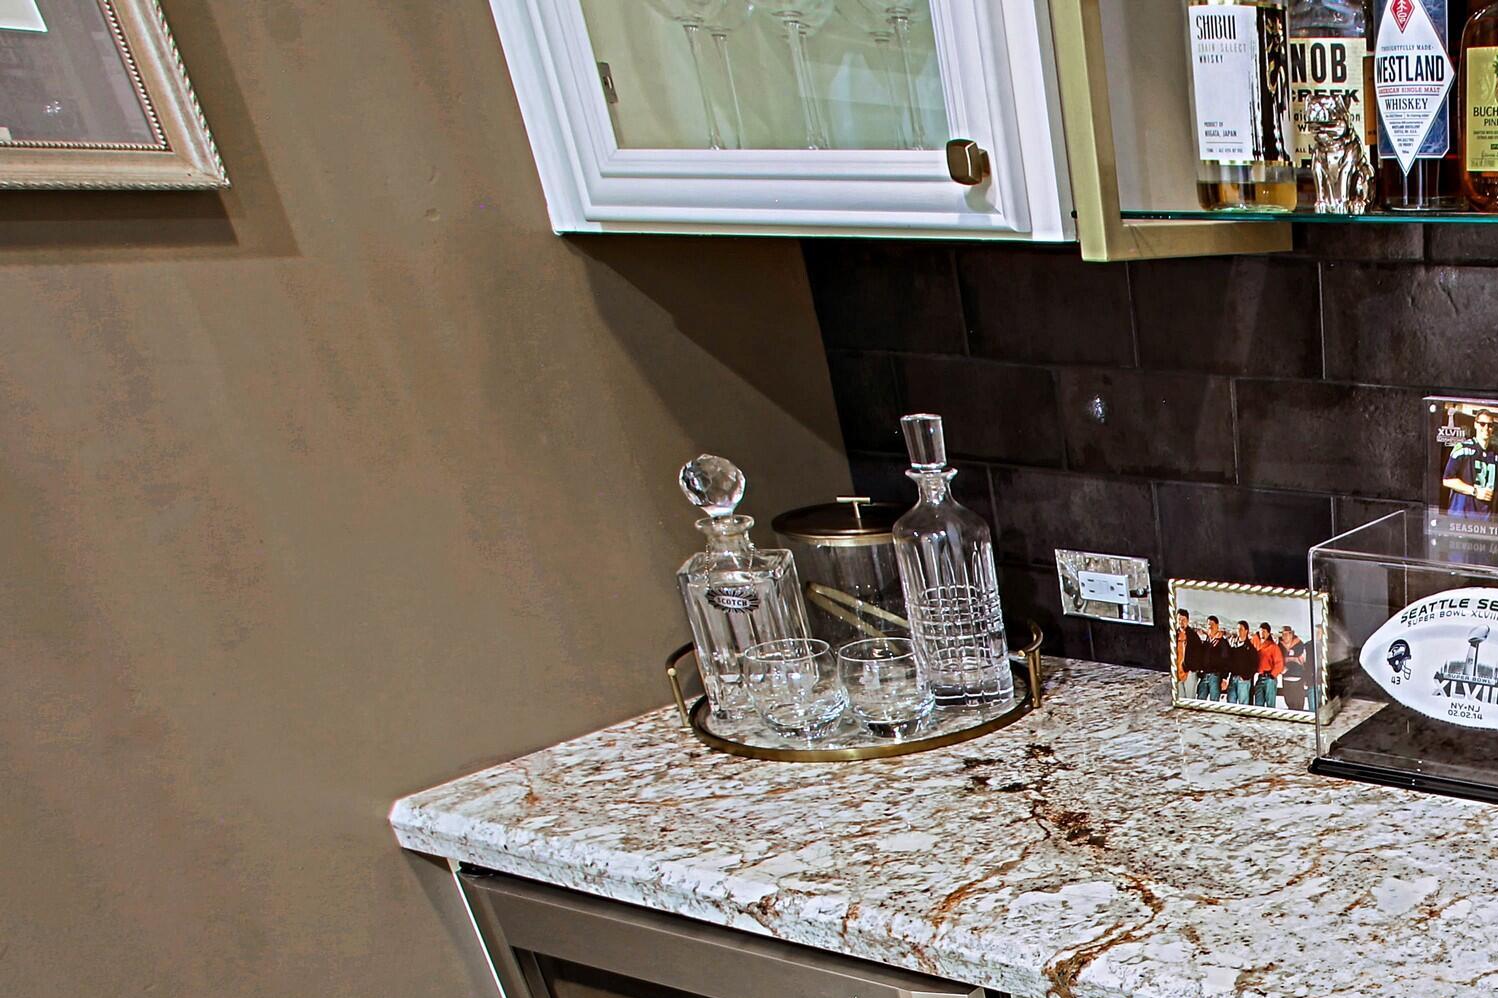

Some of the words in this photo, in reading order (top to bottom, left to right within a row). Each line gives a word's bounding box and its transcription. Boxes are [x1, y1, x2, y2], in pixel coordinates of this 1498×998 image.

[1196, 14, 1236, 40] SHIBUI
[1376, 54, 1445, 84] WESTLAND
[1384, 97, 1429, 111] WHISKEY
[1450, 522, 1486, 534] SEASON
[717, 596, 748, 606] SCOTCH
[1401, 598, 1471, 624] SEATTLE
[1408, 613, 1435, 627] SUPER
[1440, 609, 1466, 618] BOWL
[1391, 676, 1401, 685] 43
[1447, 709, 1483, 719] 02.02.14
